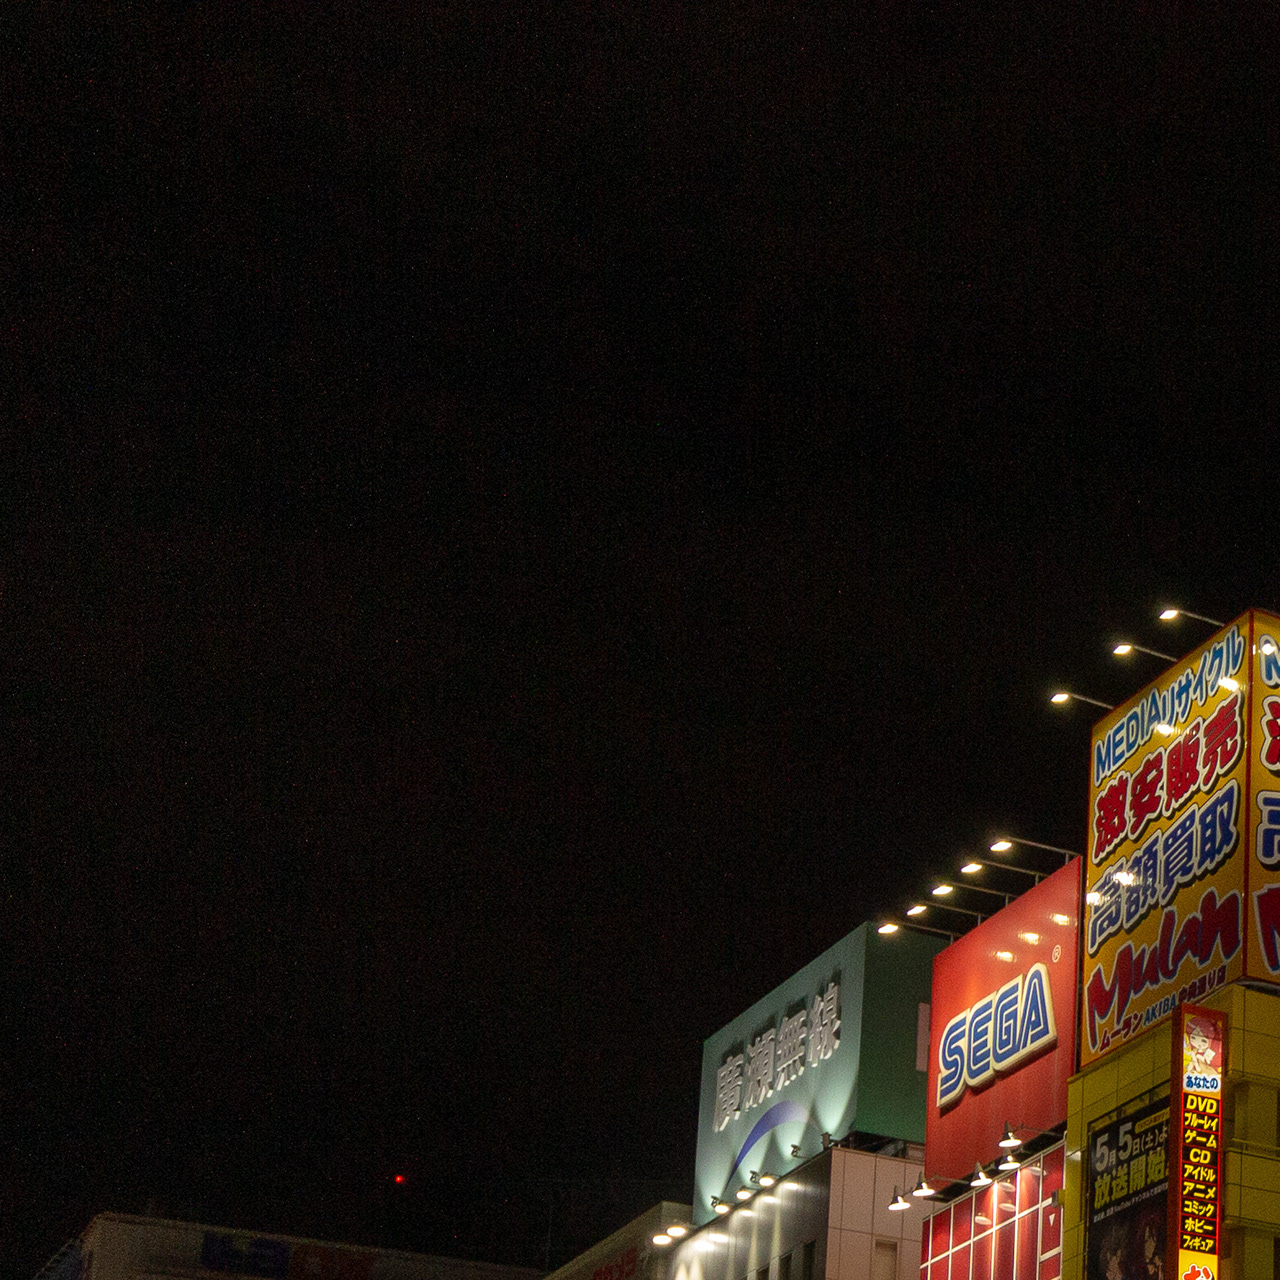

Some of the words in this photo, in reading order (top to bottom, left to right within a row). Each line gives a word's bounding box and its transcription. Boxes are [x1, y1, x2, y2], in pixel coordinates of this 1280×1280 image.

[1092, 698, 1242, 863] 激安販売
[1088, 780, 1239, 956] 高額買取
[1085, 889, 1242, 1050] Mulan
[1143, 997, 1177, 1028] AKIBA
[936, 962, 1058, 1109] SEGA
[1185, 1074, 1219, 1090] あなたの
[1185, 1094, 1218, 1114] DVD
[1184, 1112, 1218, 1132] ブルーレイ
[1184, 1131, 1217, 1149] ゲーム
[1189, 1146, 1210, 1165] CD
[1183, 1164, 1216, 1183] アイドル
[1182, 1181, 1216, 1200] アニメ
[1183, 1200, 1214, 1217] コミック
[1184, 1217, 1213, 1234] ホビー
[1182, 1234, 1214, 1252] フィギュア
